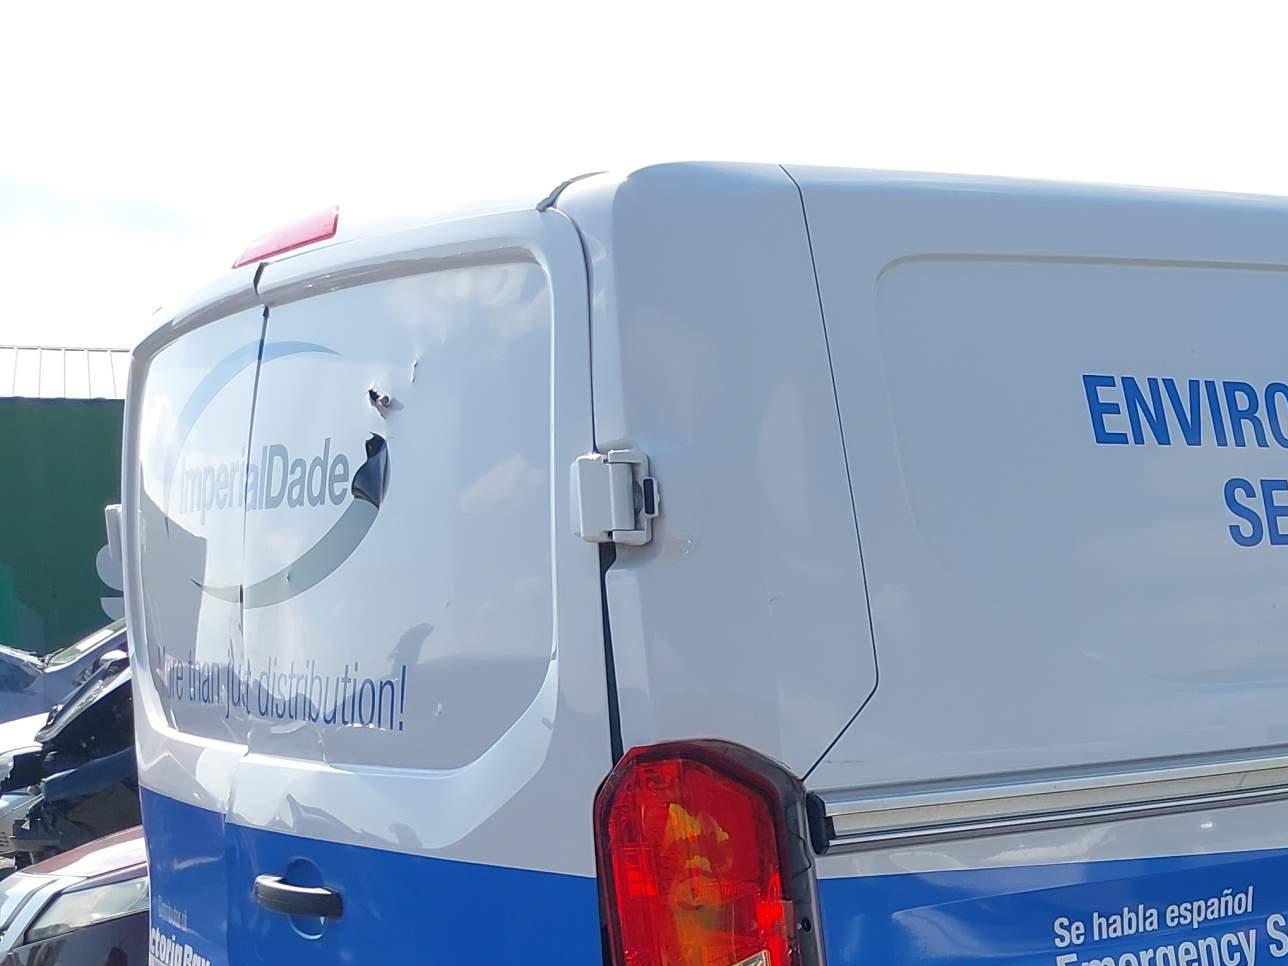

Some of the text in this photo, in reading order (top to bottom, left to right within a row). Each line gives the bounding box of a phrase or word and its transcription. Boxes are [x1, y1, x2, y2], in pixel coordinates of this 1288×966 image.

[179, 437, 350, 525] ImperialDade
[257, 656, 407, 731] distribution!
[1054, 886, 1254, 948] Se habla español
